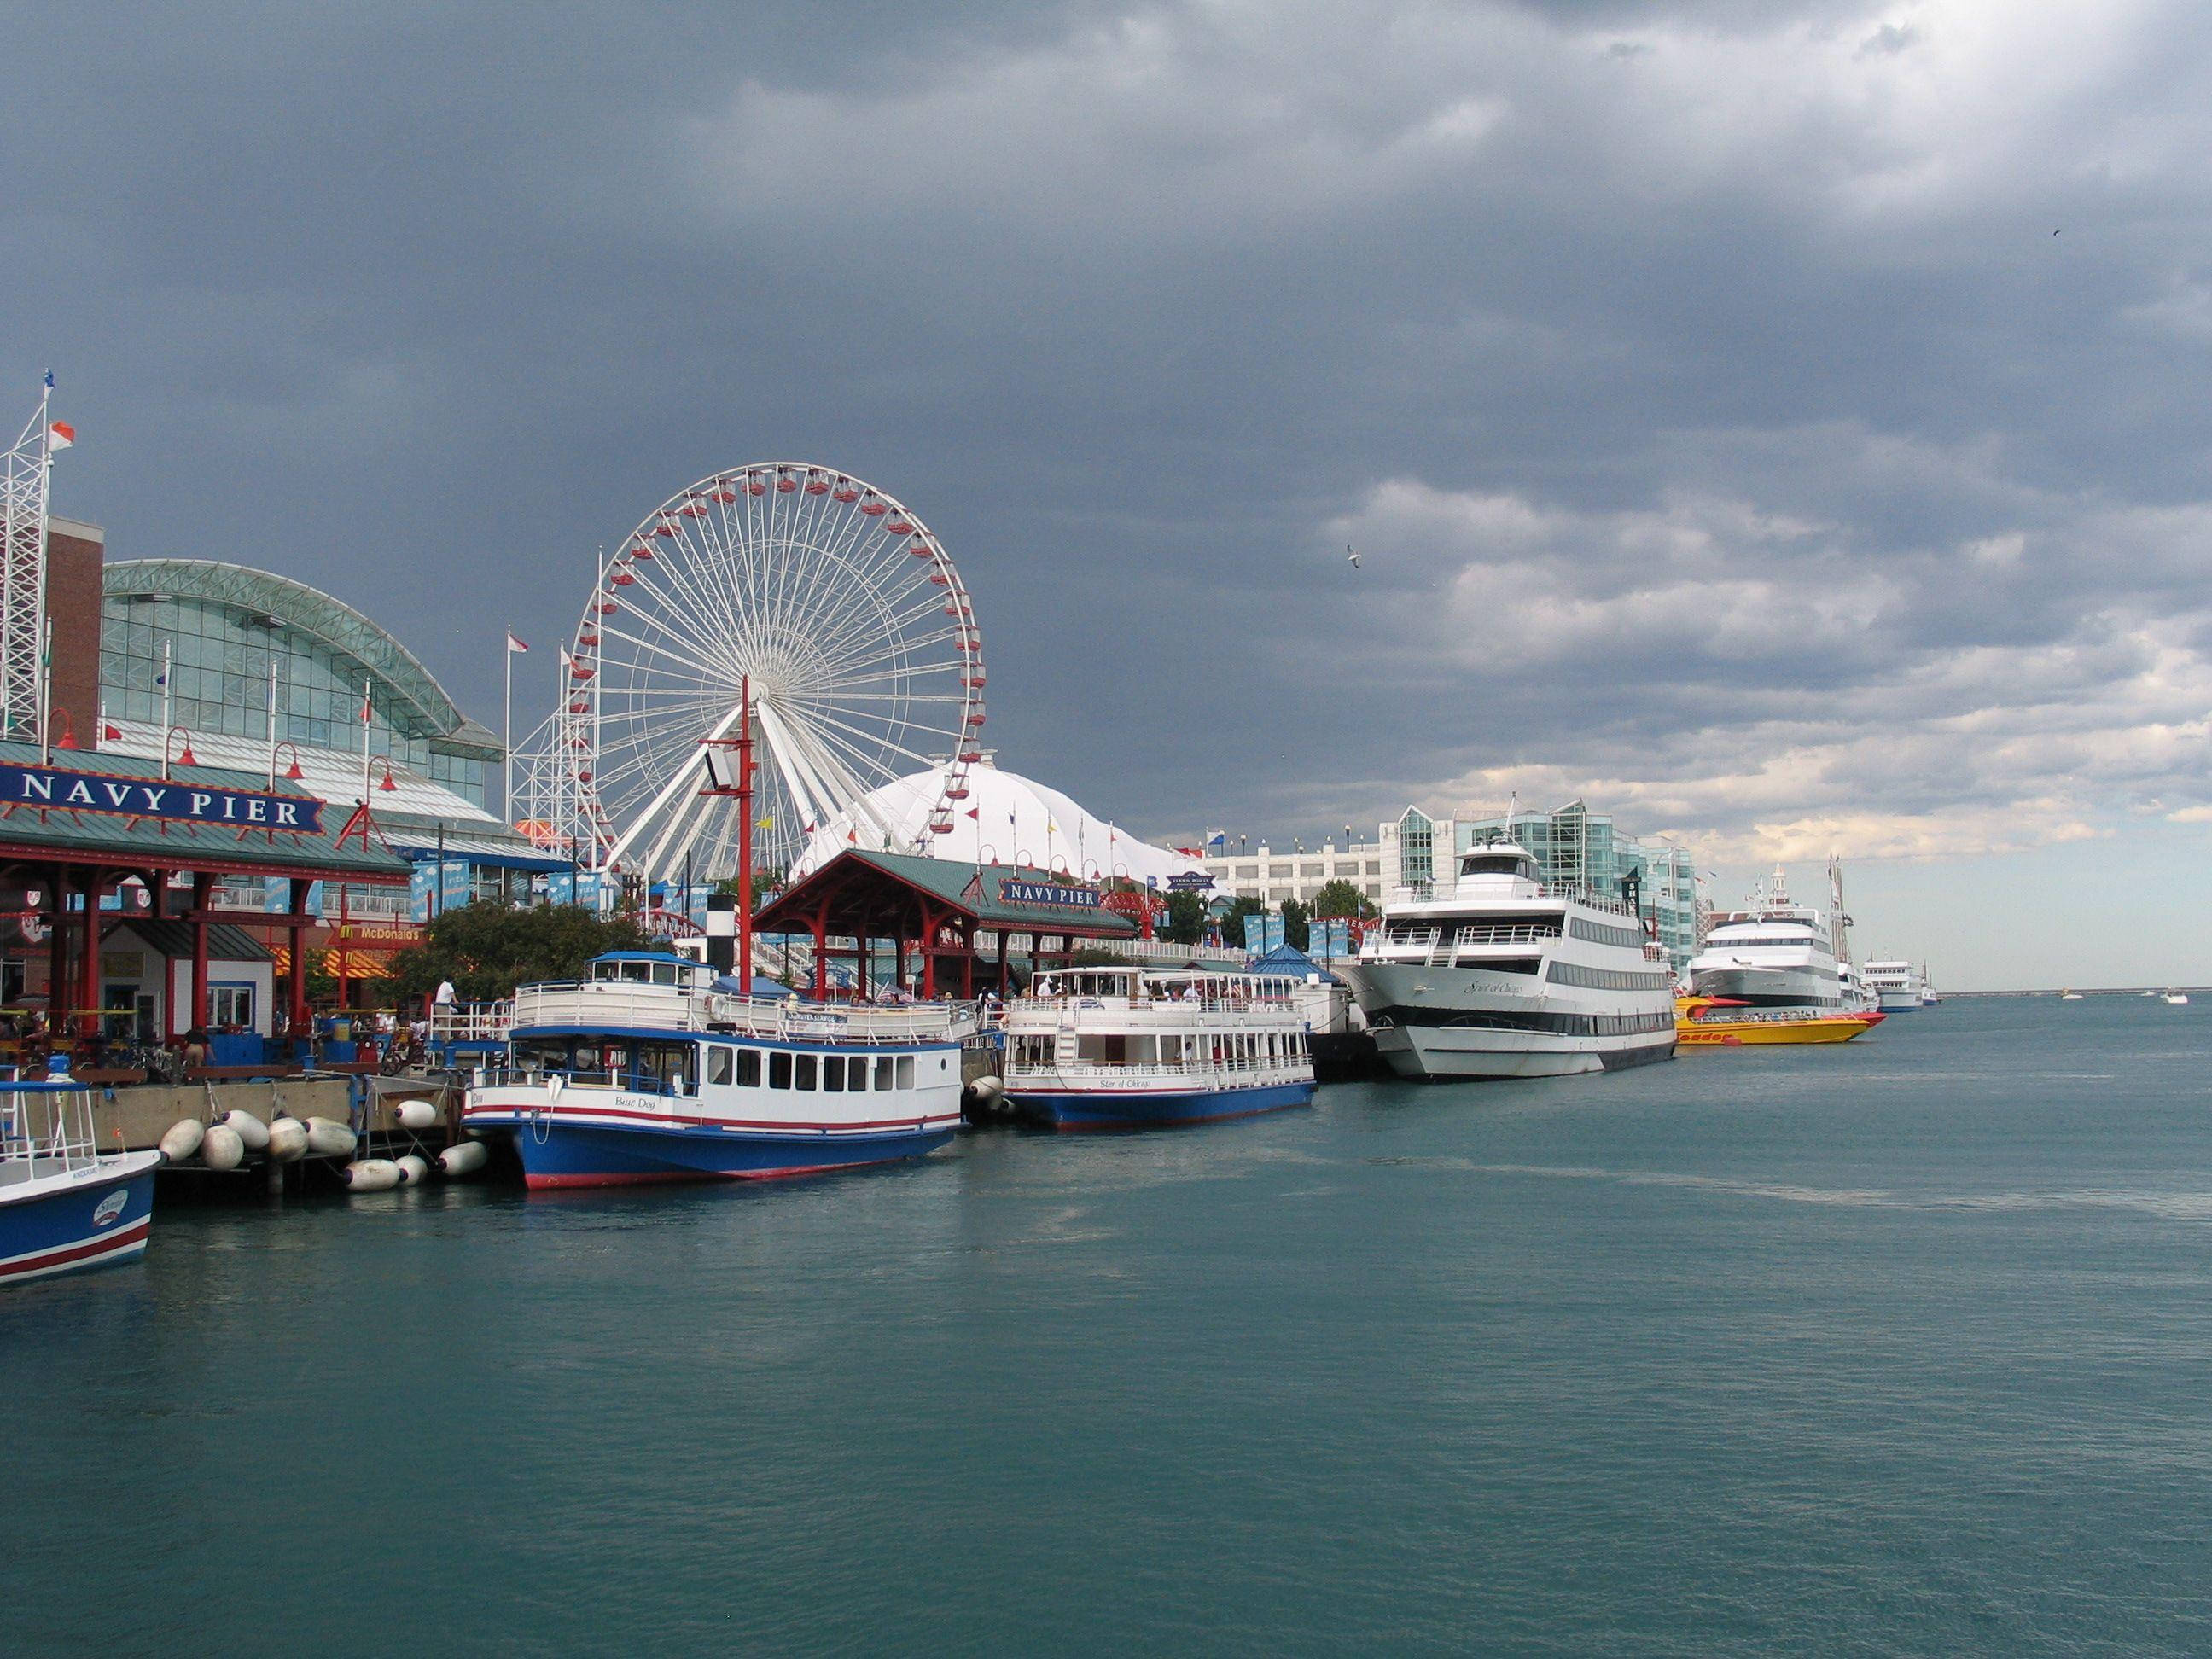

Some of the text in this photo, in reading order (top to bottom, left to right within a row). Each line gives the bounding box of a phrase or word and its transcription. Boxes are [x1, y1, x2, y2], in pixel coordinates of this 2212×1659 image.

[22, 773, 299, 825] NAVY PIER
[1011, 884, 1094, 905] NAVY PIER
[362, 928, 419, 940] McDonald's
[1679, 1033, 1734, 1043] eado
[1100, 1080, 1115, 1088] Star
[638, 1097, 655, 1111] Dog
